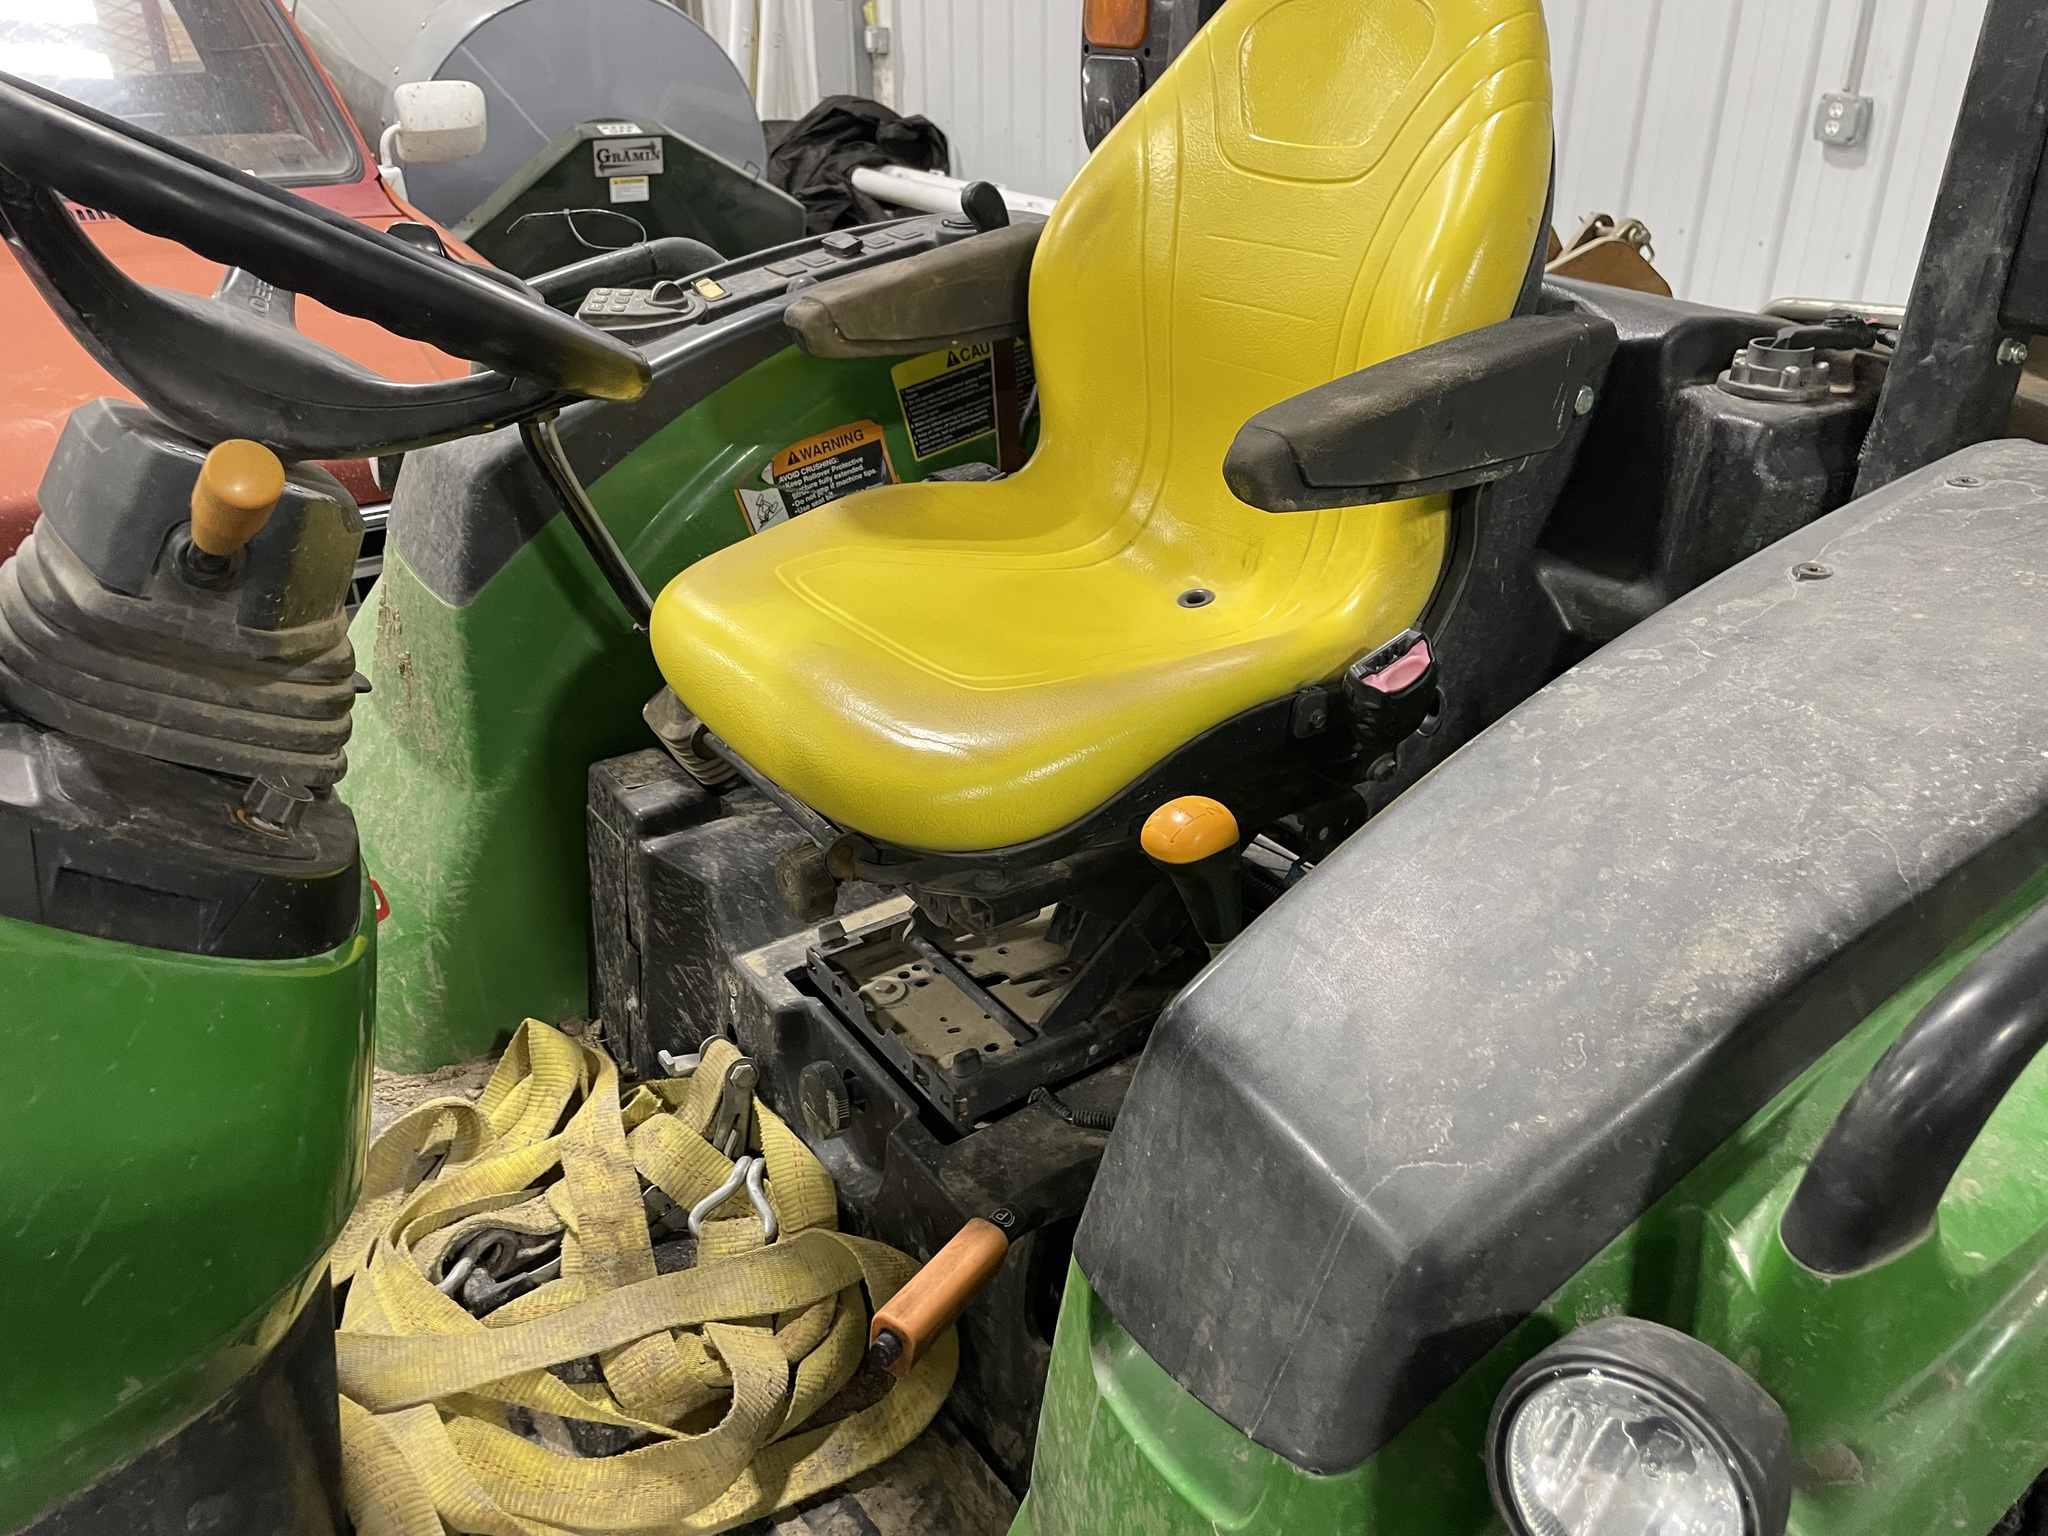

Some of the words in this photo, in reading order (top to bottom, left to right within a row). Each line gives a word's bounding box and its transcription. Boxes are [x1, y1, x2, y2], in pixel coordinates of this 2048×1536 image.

[800, 429, 864, 461] WARNING
[779, 471, 800, 483] AVOID
[801, 457, 839, 475] CRUSHING:
[785, 478, 803, 489] Keep
[803, 468, 830, 483] Rollover
[831, 457, 864, 473] Protective
[819, 476, 833, 486] fully
[834, 465, 864, 480] extended.
[794, 499, 805, 507] Do
[805, 492, 817, 502] not
[836, 475, 862, 488] machine
[797, 504, 811, 514] Use
[810, 496, 826, 508] seat
